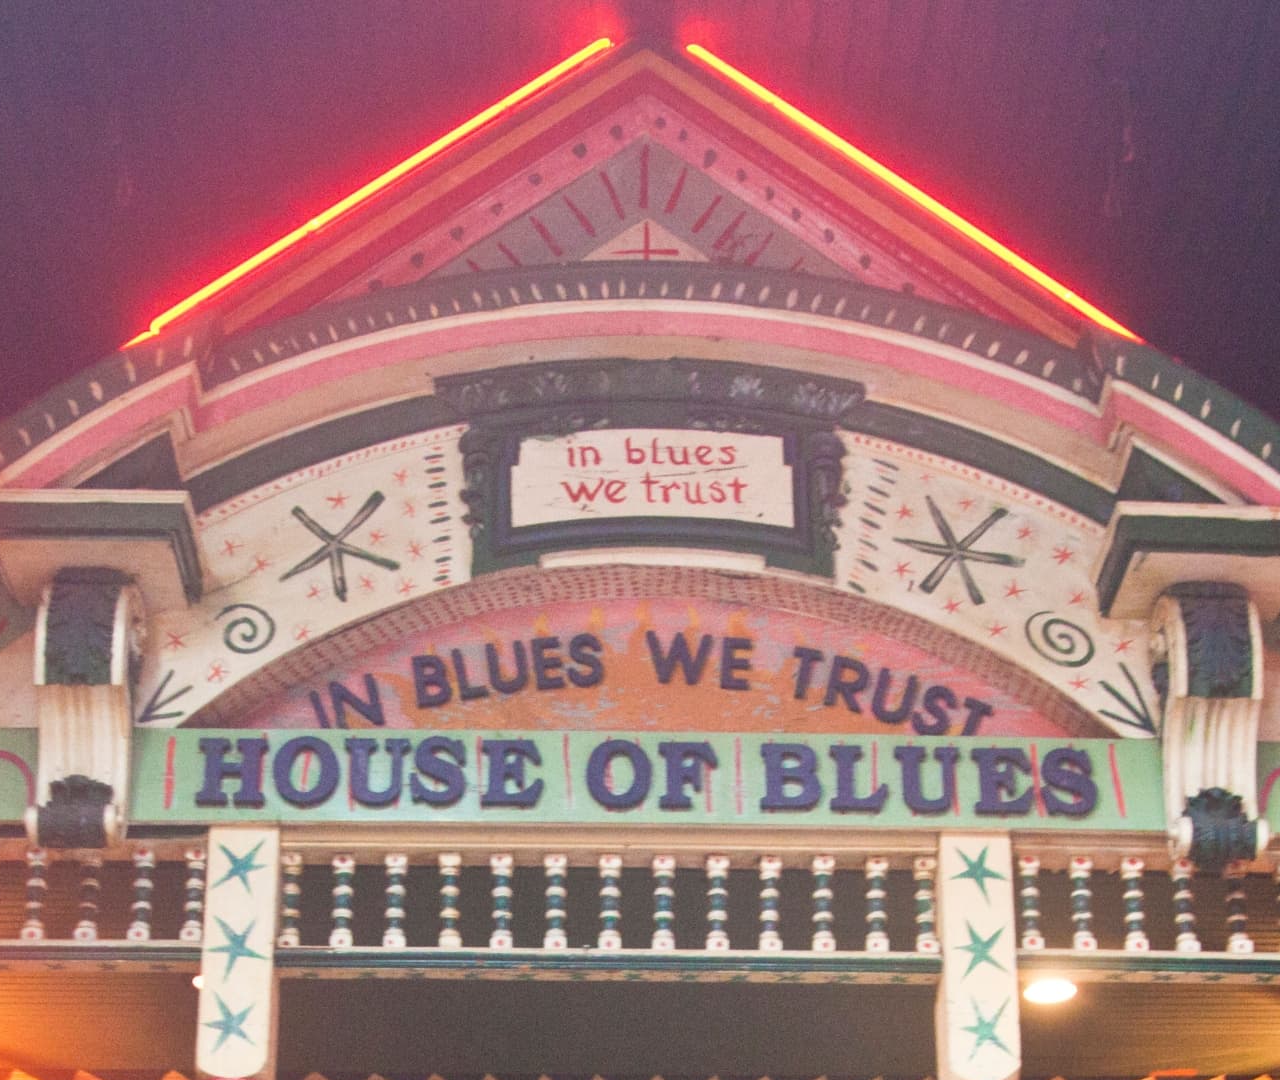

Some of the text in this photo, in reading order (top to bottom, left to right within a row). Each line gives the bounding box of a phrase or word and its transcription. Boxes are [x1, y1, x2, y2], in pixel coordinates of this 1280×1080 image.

[566, 437, 738, 468] in blues
[561, 472, 750, 506] we trust
[307, 629, 996, 736] IN BLUES WE TRUST
[194, 735, 1100, 818] HOUSE OF BLUES
